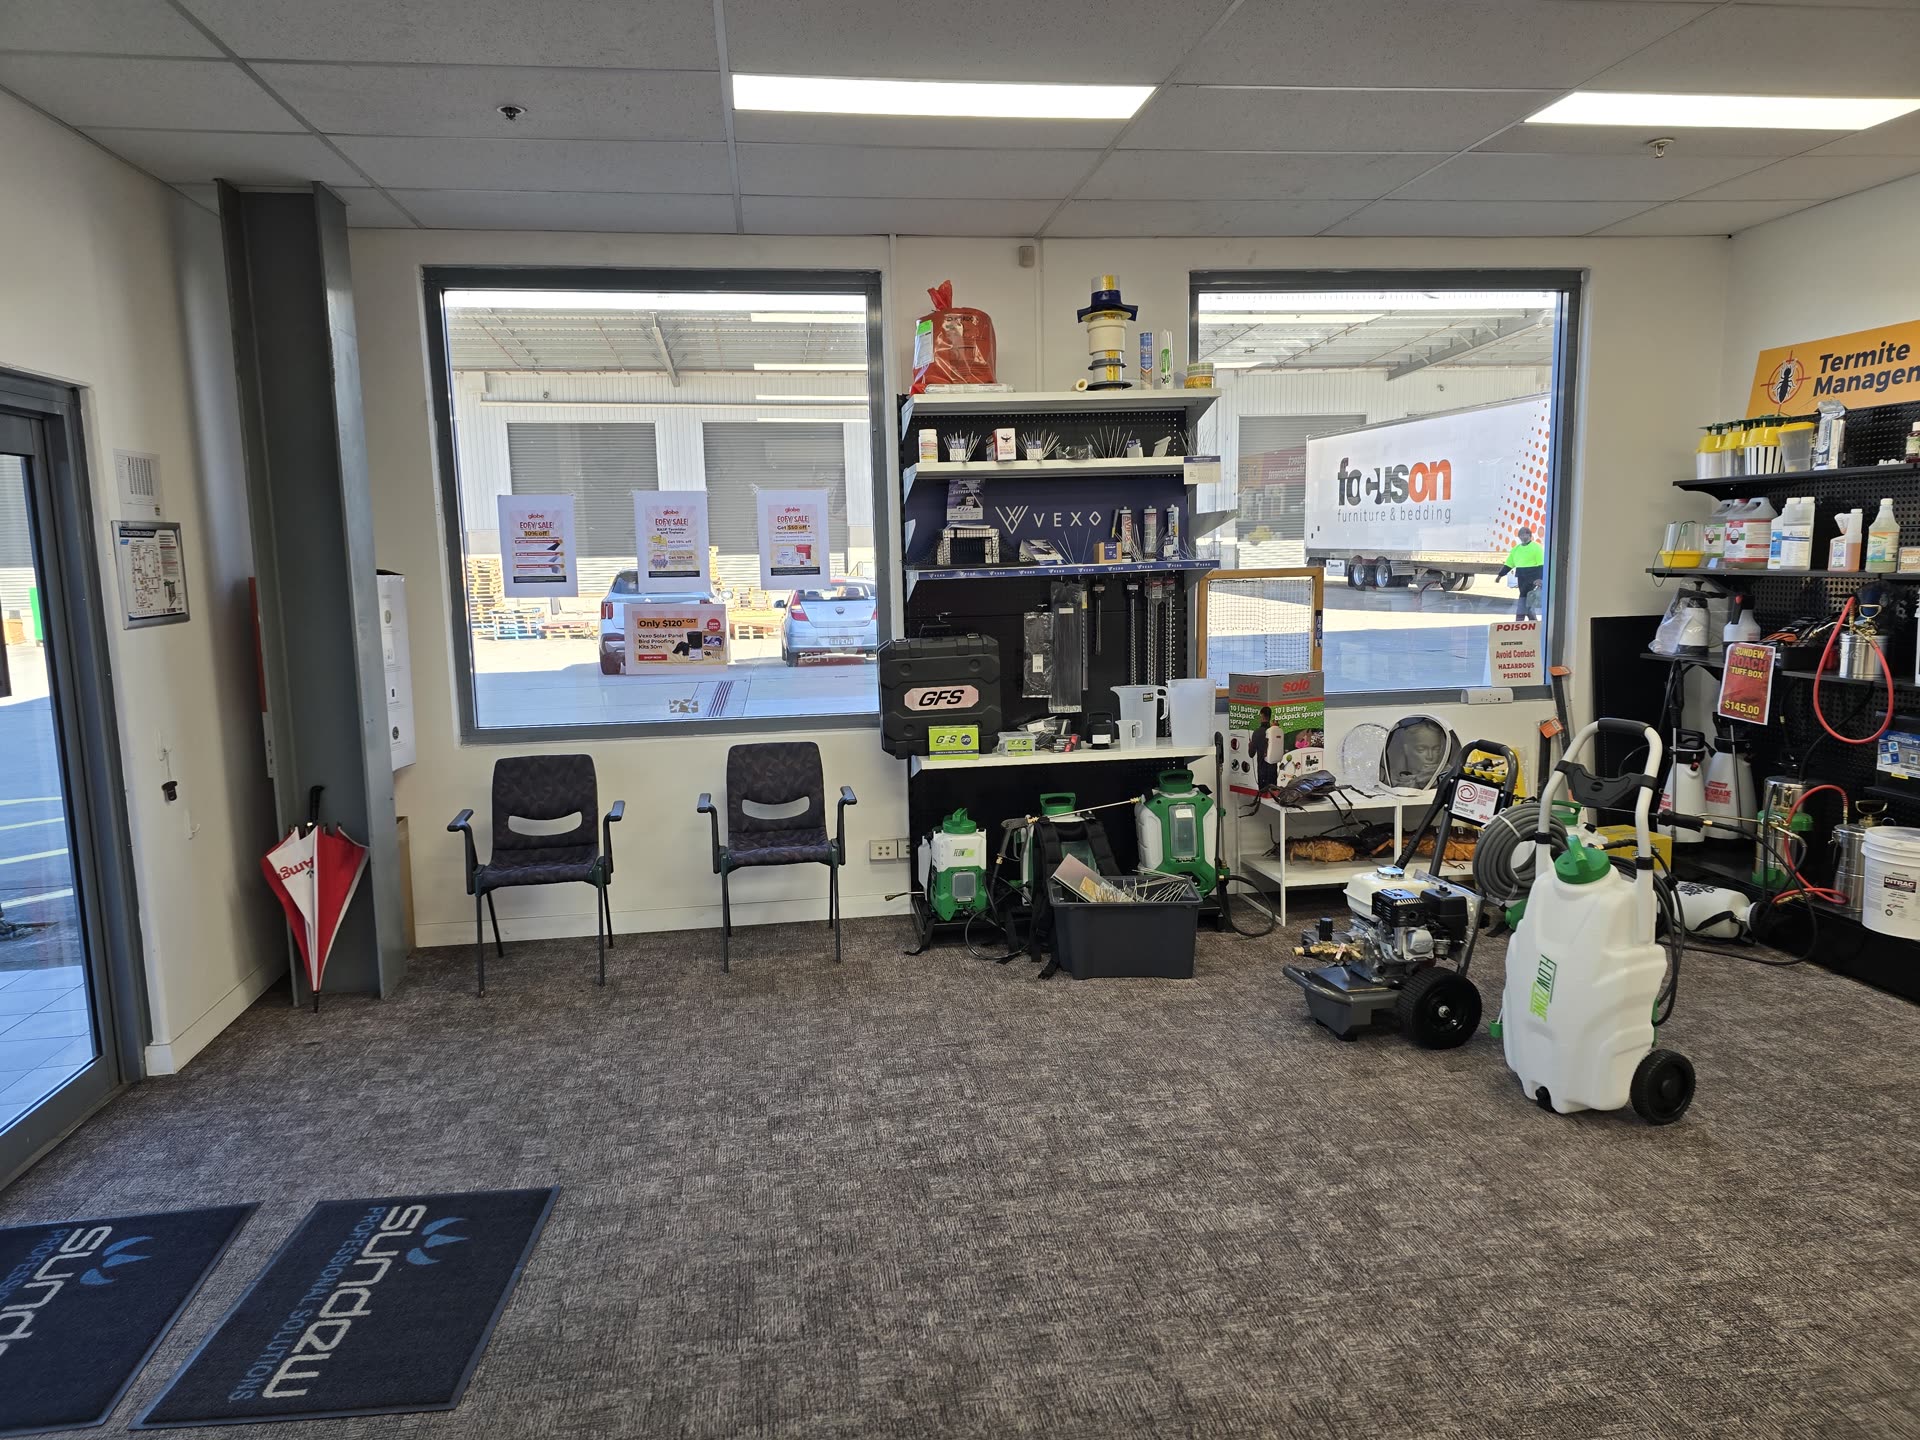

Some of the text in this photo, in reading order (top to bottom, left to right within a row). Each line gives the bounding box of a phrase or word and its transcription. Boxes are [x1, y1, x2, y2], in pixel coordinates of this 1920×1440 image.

[1819, 341, 1911, 374] Termite
[1033, 511, 1101, 527] VEXO
[1337, 505, 1451, 524] furniture & bedding
[639, 620, 660, 628] Only
[1496, 623, 1536, 631] POISON
[1496, 649, 1535, 659] Avoid Contact
[1735, 647, 1765, 659] SUNDEW
[1730, 656, 1768, 672] ROACH
[1730, 666, 1763, 679] TUFF BOX
[1236, 683, 1260, 694] solo
[1282, 678, 1310, 692] solo
[918, 690, 965, 706] GFS
[1241, 706, 1261, 714] Battery
[1286, 705, 1307, 713] Battery
[1724, 700, 1760, 715] $145.00
[1230, 711, 1255, 720] backpack
[1274, 711, 1323, 721] backpack sprayer
[1230, 719, 1250, 727] sprayer
[936, 735, 957, 743] GFS
[1885, 877, 1915, 887] DITRAC
[228, 1206, 387, 1402] PROFESSIONAL SOLUTIONS
